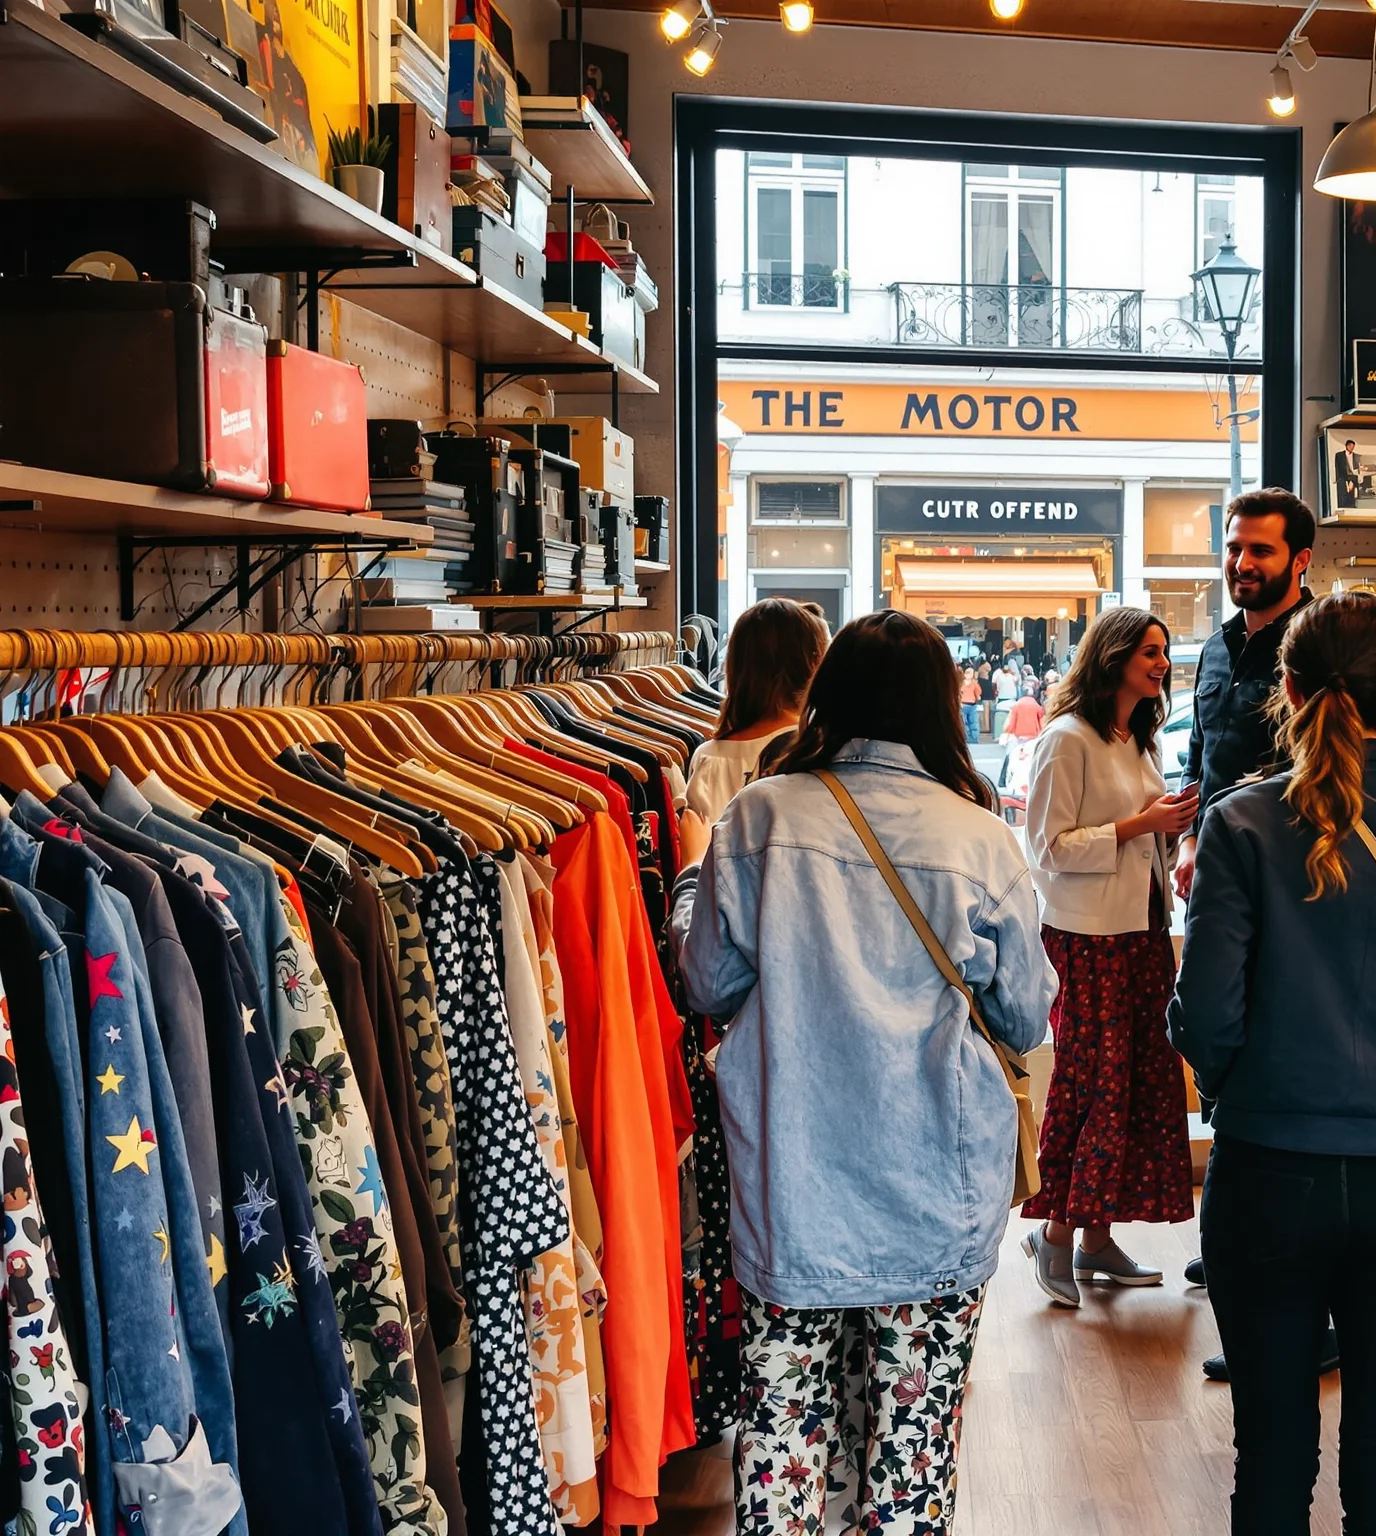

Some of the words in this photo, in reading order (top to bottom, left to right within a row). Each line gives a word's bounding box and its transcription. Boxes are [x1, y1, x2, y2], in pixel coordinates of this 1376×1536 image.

[752, 389, 844, 427] THE
[899, 393, 1081, 433] MOTOR
[922, 500, 979, 519] CUTR
[989, 501, 1078, 520] OFFEND
